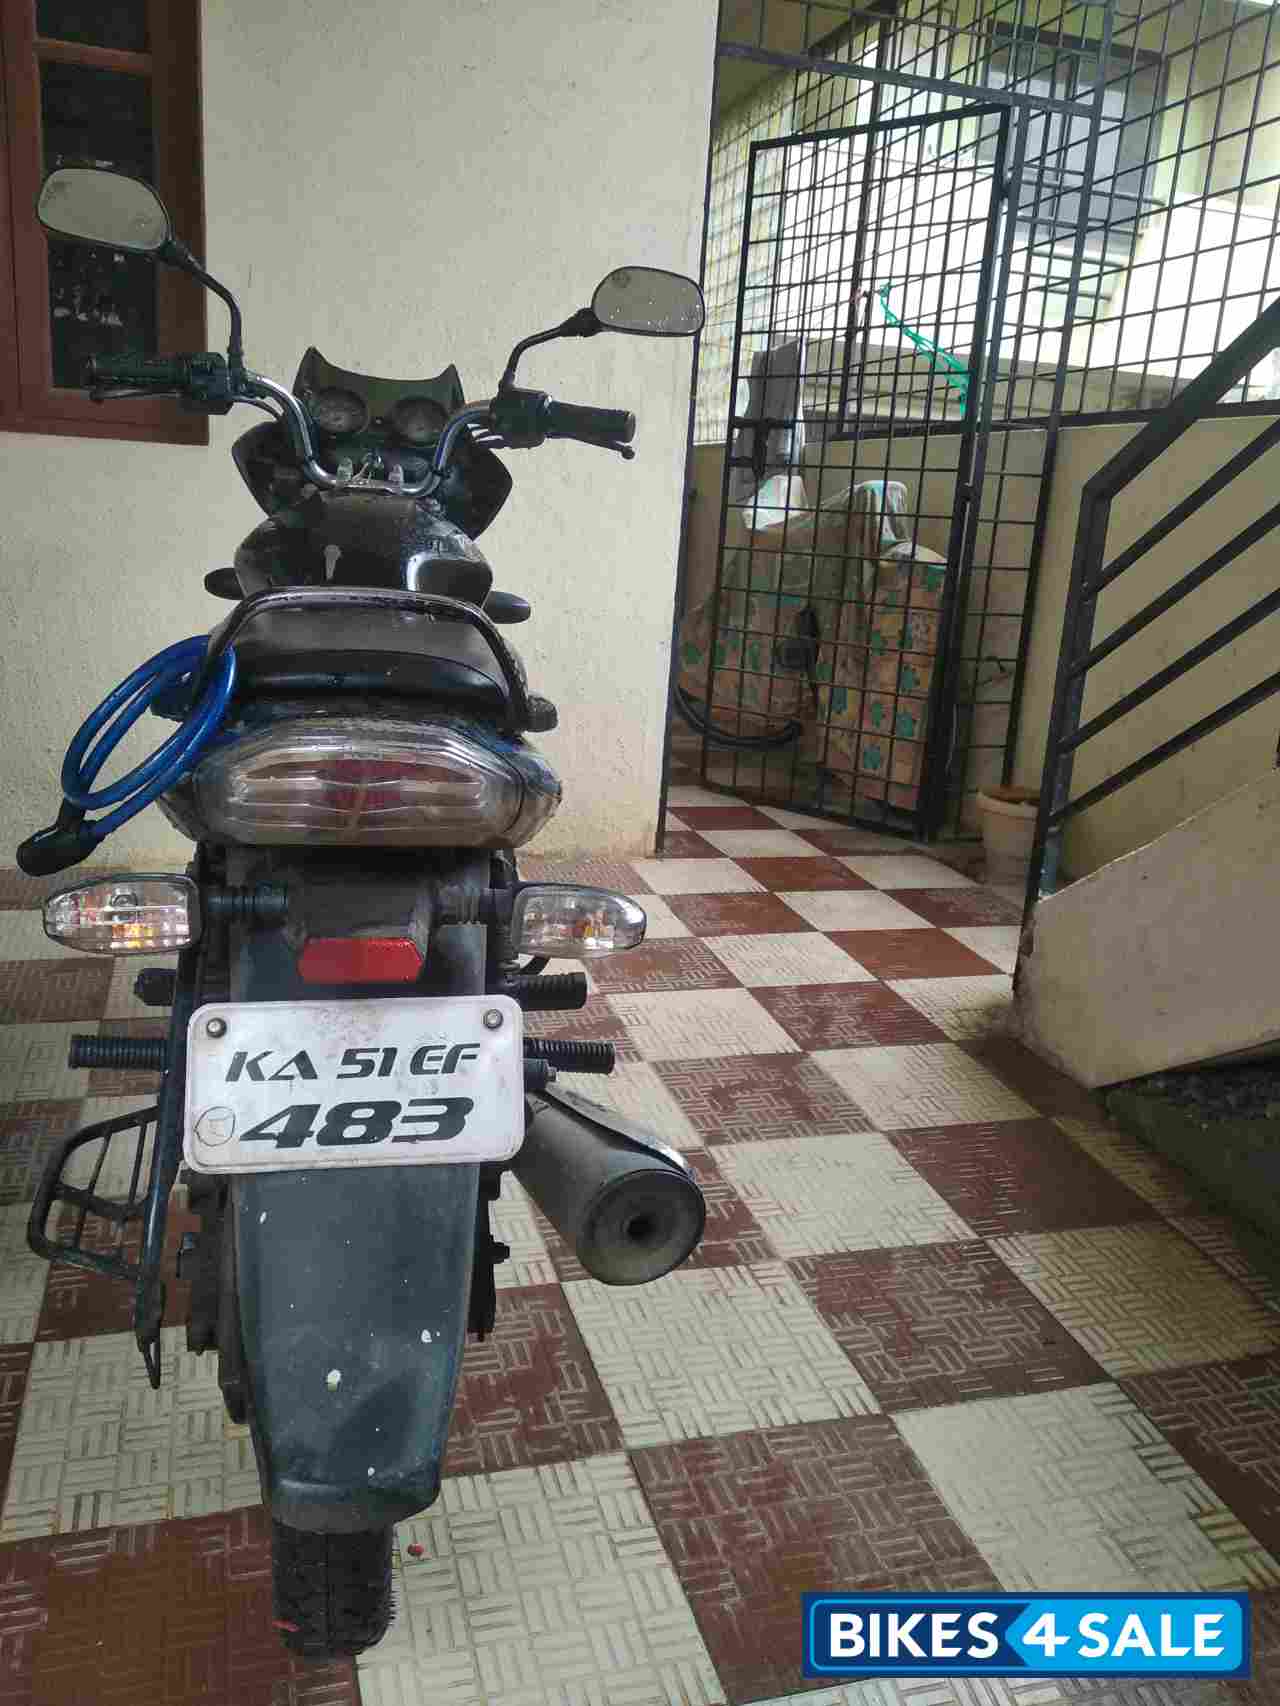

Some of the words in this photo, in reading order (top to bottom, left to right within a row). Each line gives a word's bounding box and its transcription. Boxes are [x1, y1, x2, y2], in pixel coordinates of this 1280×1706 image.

[225, 1050, 318, 1082] KA
[336, 1047, 397, 1080] 51
[410, 1043, 481, 1075] EF
[239, 1097, 474, 1149] 483
